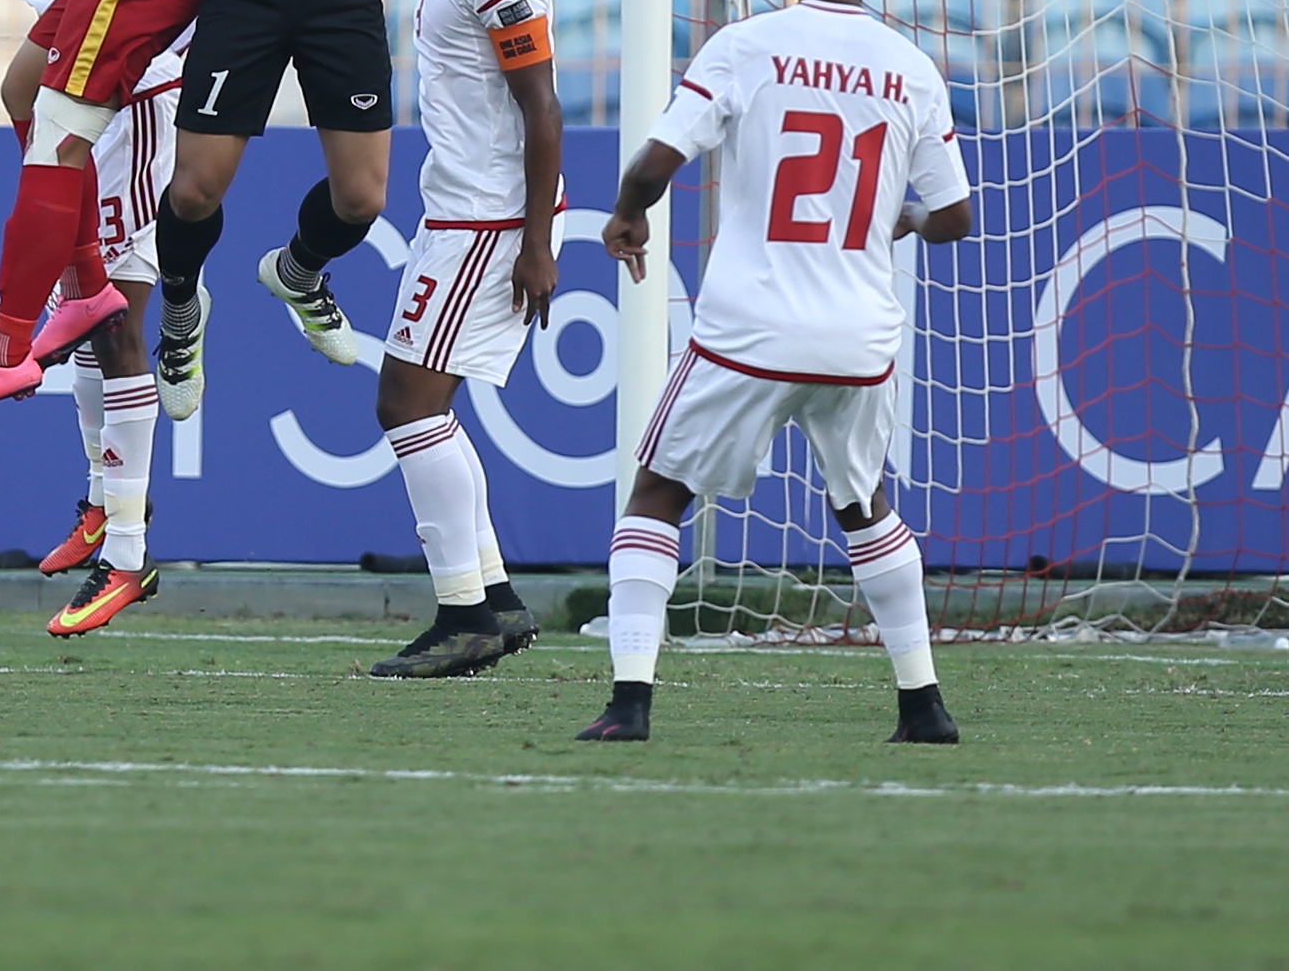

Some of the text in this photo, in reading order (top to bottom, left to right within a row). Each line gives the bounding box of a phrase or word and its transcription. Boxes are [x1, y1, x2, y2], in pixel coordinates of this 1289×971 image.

[197, 69, 230, 116] 1
[771, 56, 909, 104] YAHYA H.
[766, 110, 889, 250] 21
[402, 274, 438, 323] 3
[1033, 204, 1289, 496] C
